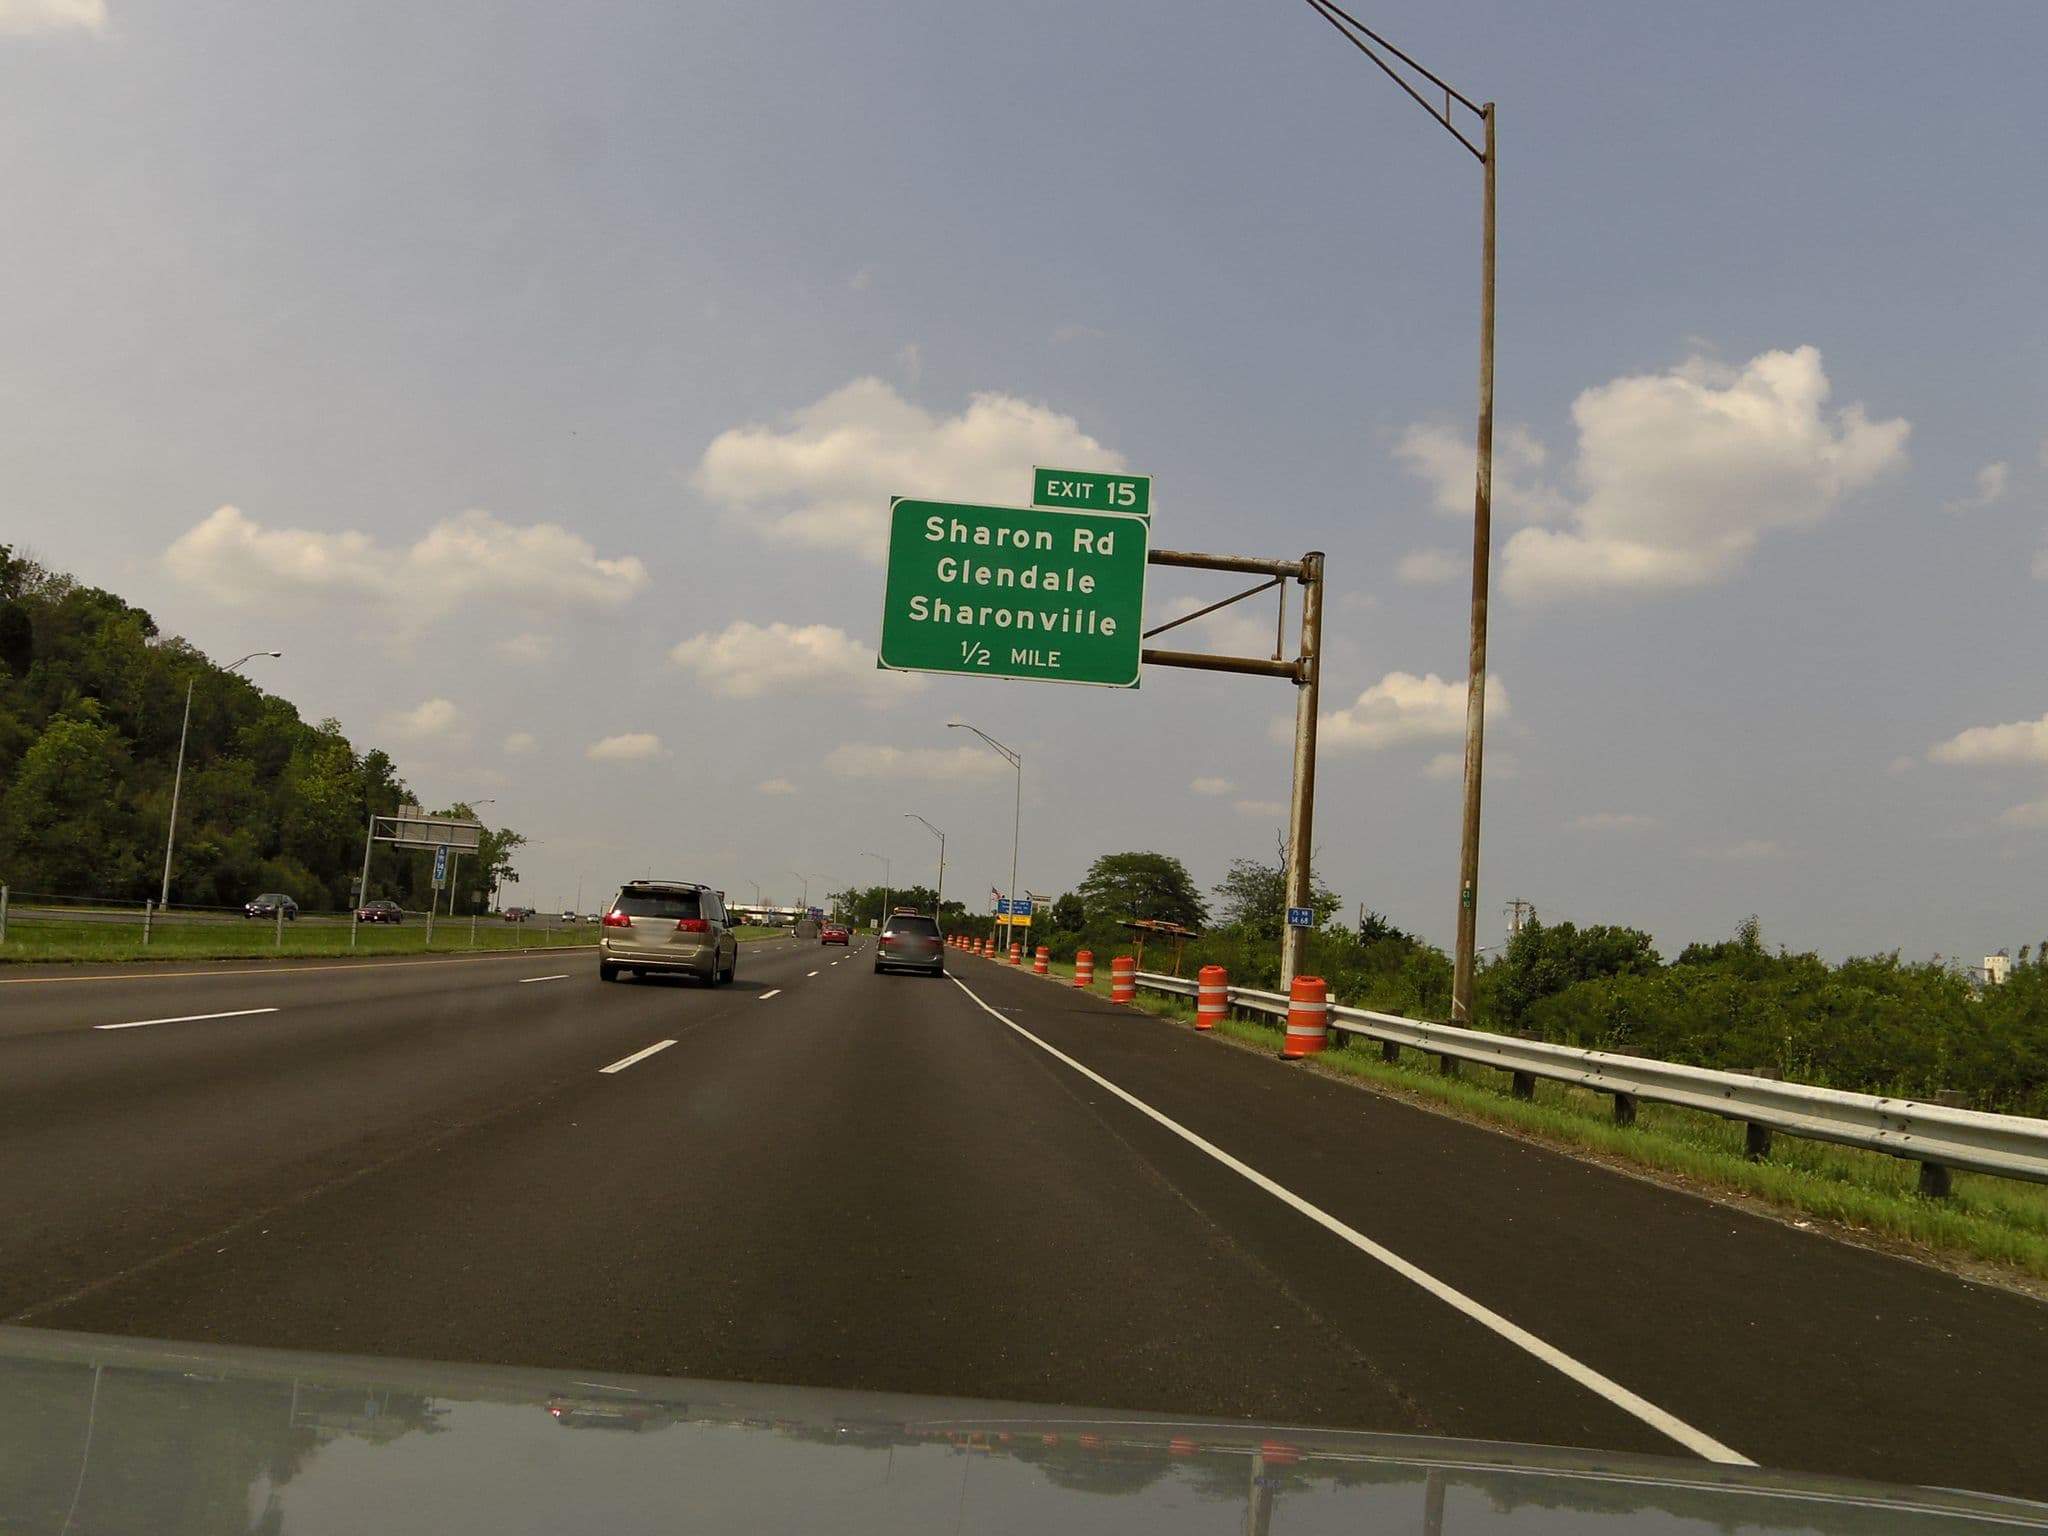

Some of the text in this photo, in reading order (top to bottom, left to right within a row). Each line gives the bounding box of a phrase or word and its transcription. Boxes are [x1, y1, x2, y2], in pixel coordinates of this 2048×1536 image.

[1047, 480, 1136, 506] EXIT 15
[924, 515, 1114, 556] Sharon Rd
[936, 557, 1096, 594] Glendale
[908, 595, 1117, 637] Sharonville
[1010, 648, 1061, 668] MILE
